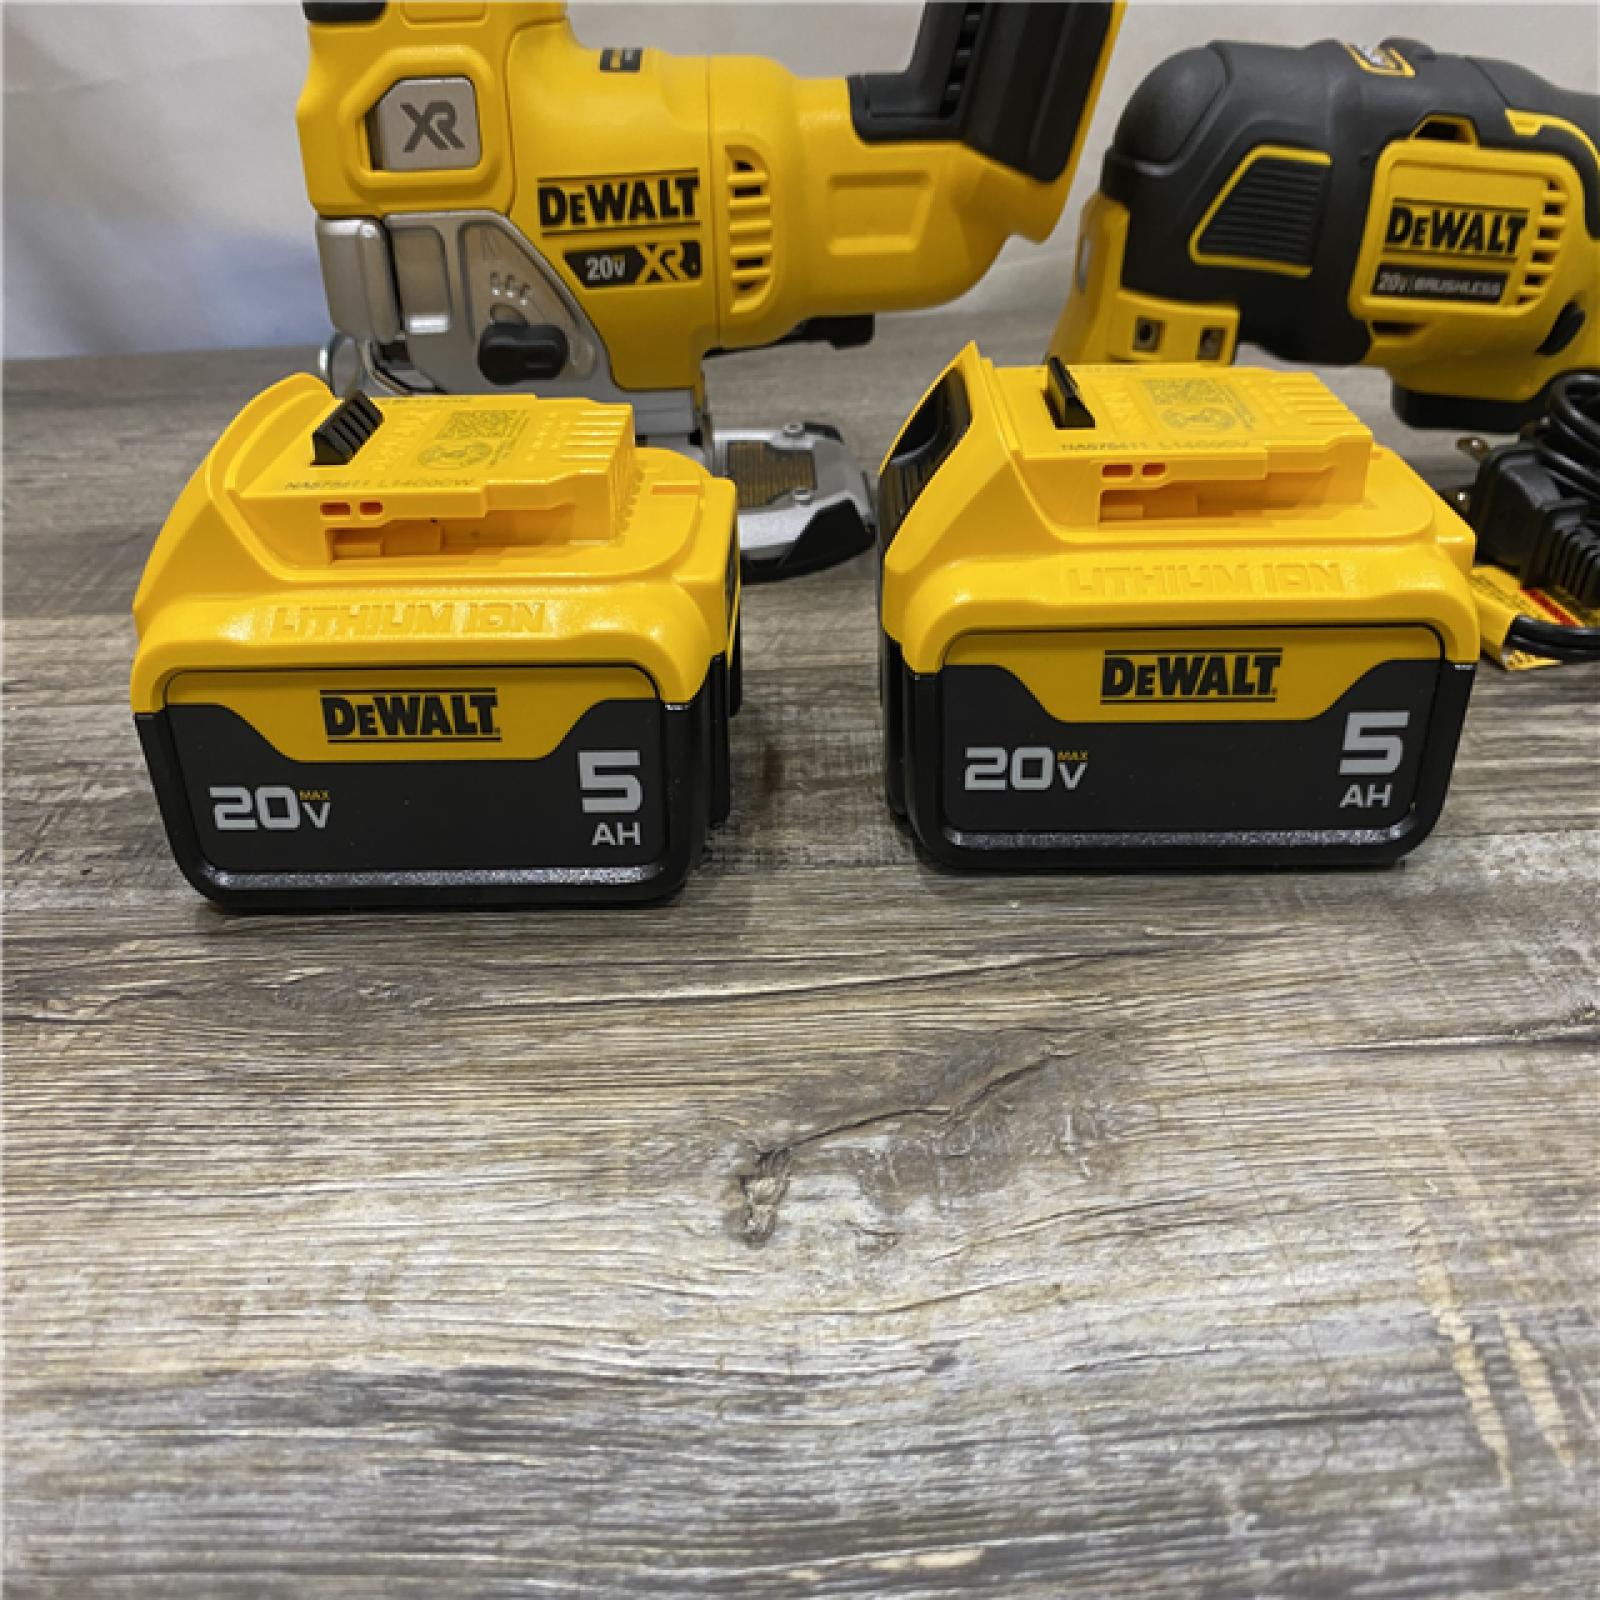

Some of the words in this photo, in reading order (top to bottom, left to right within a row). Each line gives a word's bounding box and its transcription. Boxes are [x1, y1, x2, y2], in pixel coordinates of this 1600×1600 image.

[399, 102, 466, 153] XR
[1067, 564, 1254, 596] LITHIUM
[1262, 563, 1345, 594] ION
[271, 602, 454, 639] LITHIUM
[464, 602, 547, 633] ION
[1056, 751, 1088, 761] MAX
[1338, 710, 1410, 775] 5
[299, 789, 330, 801] MAX
[577, 750, 644, 814] 5
[1338, 783, 1393, 809] AH
[591, 821, 642, 847] AH
